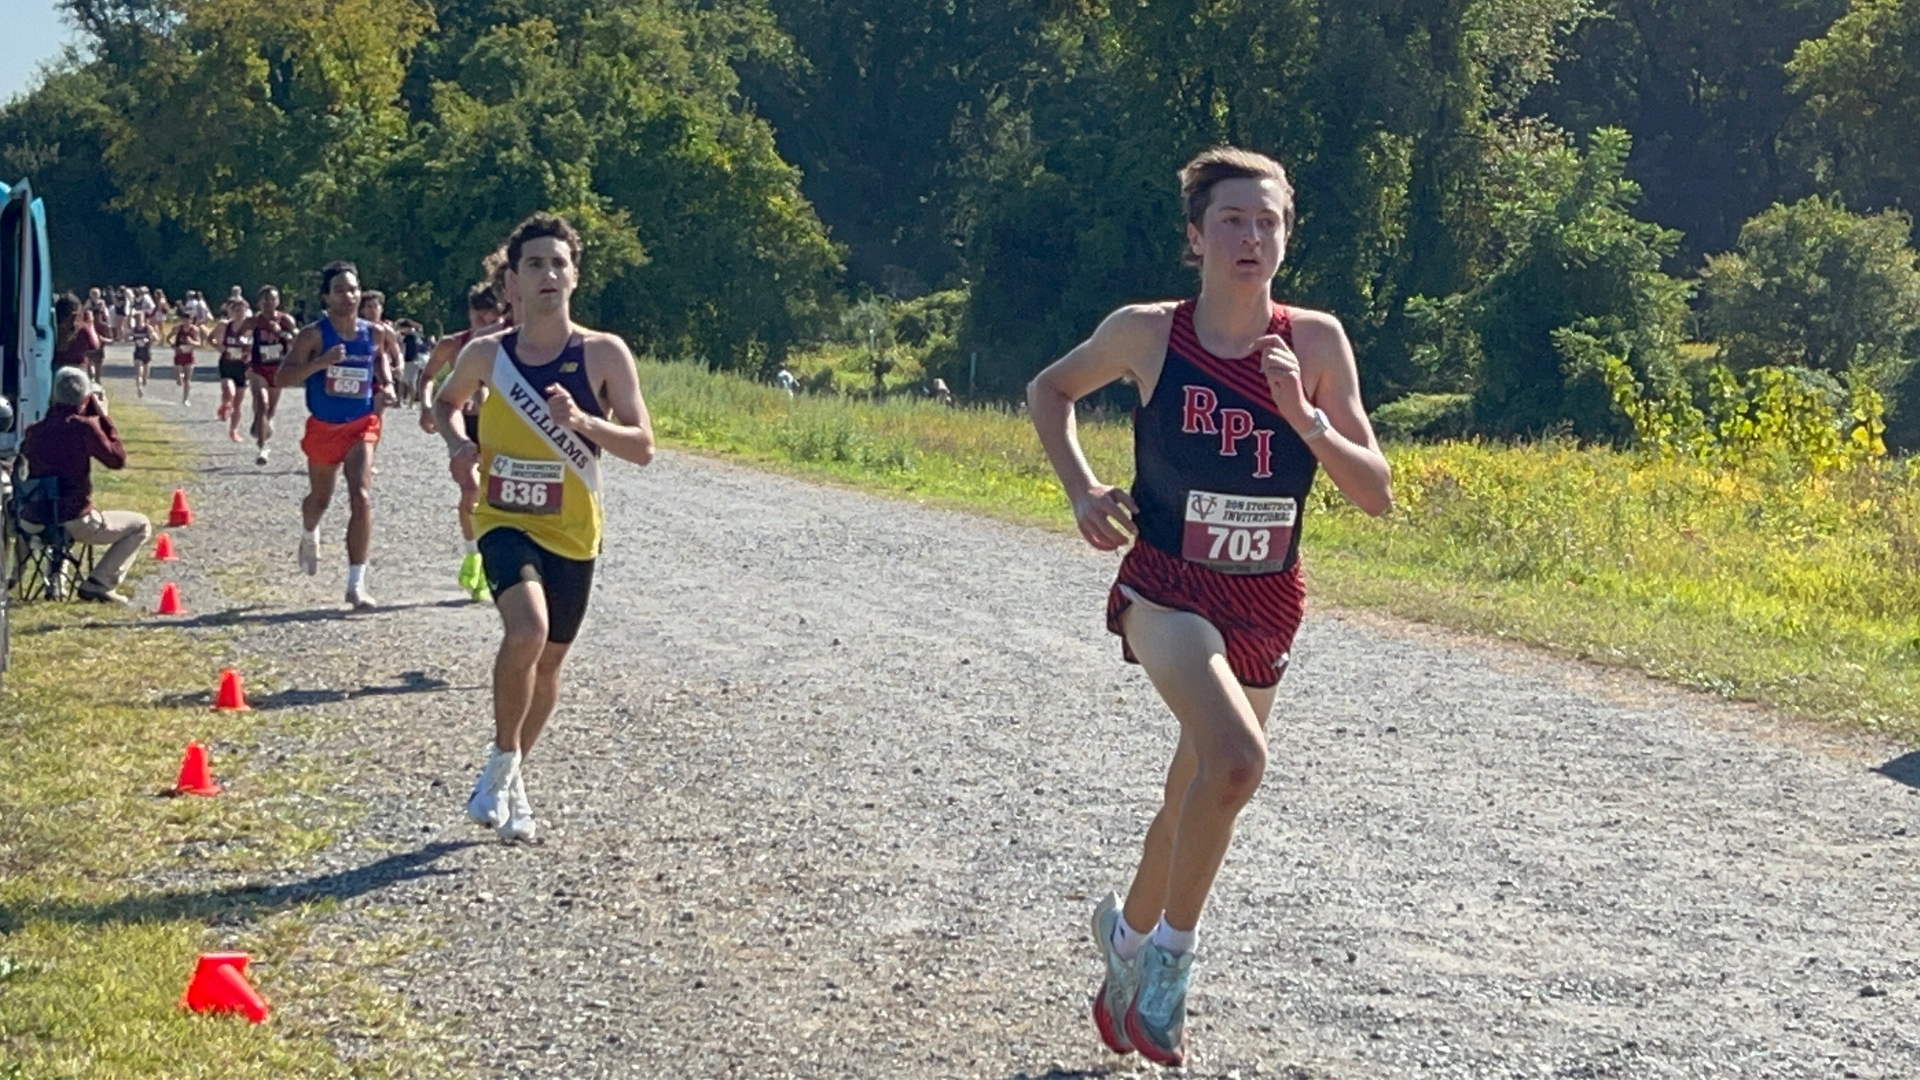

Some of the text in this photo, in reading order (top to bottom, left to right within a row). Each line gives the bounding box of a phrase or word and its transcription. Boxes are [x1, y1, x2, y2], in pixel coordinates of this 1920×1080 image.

[334, 379, 360, 394] 650
[509, 382, 589, 469] WILLIAMS
[1182, 385, 1275, 478] RPI
[501, 480, 547, 506] 836
[1224, 499, 1245, 510] RON
[1223, 511, 1291, 523] INVITATIONAL
[1207, 525, 1271, 562] 703
